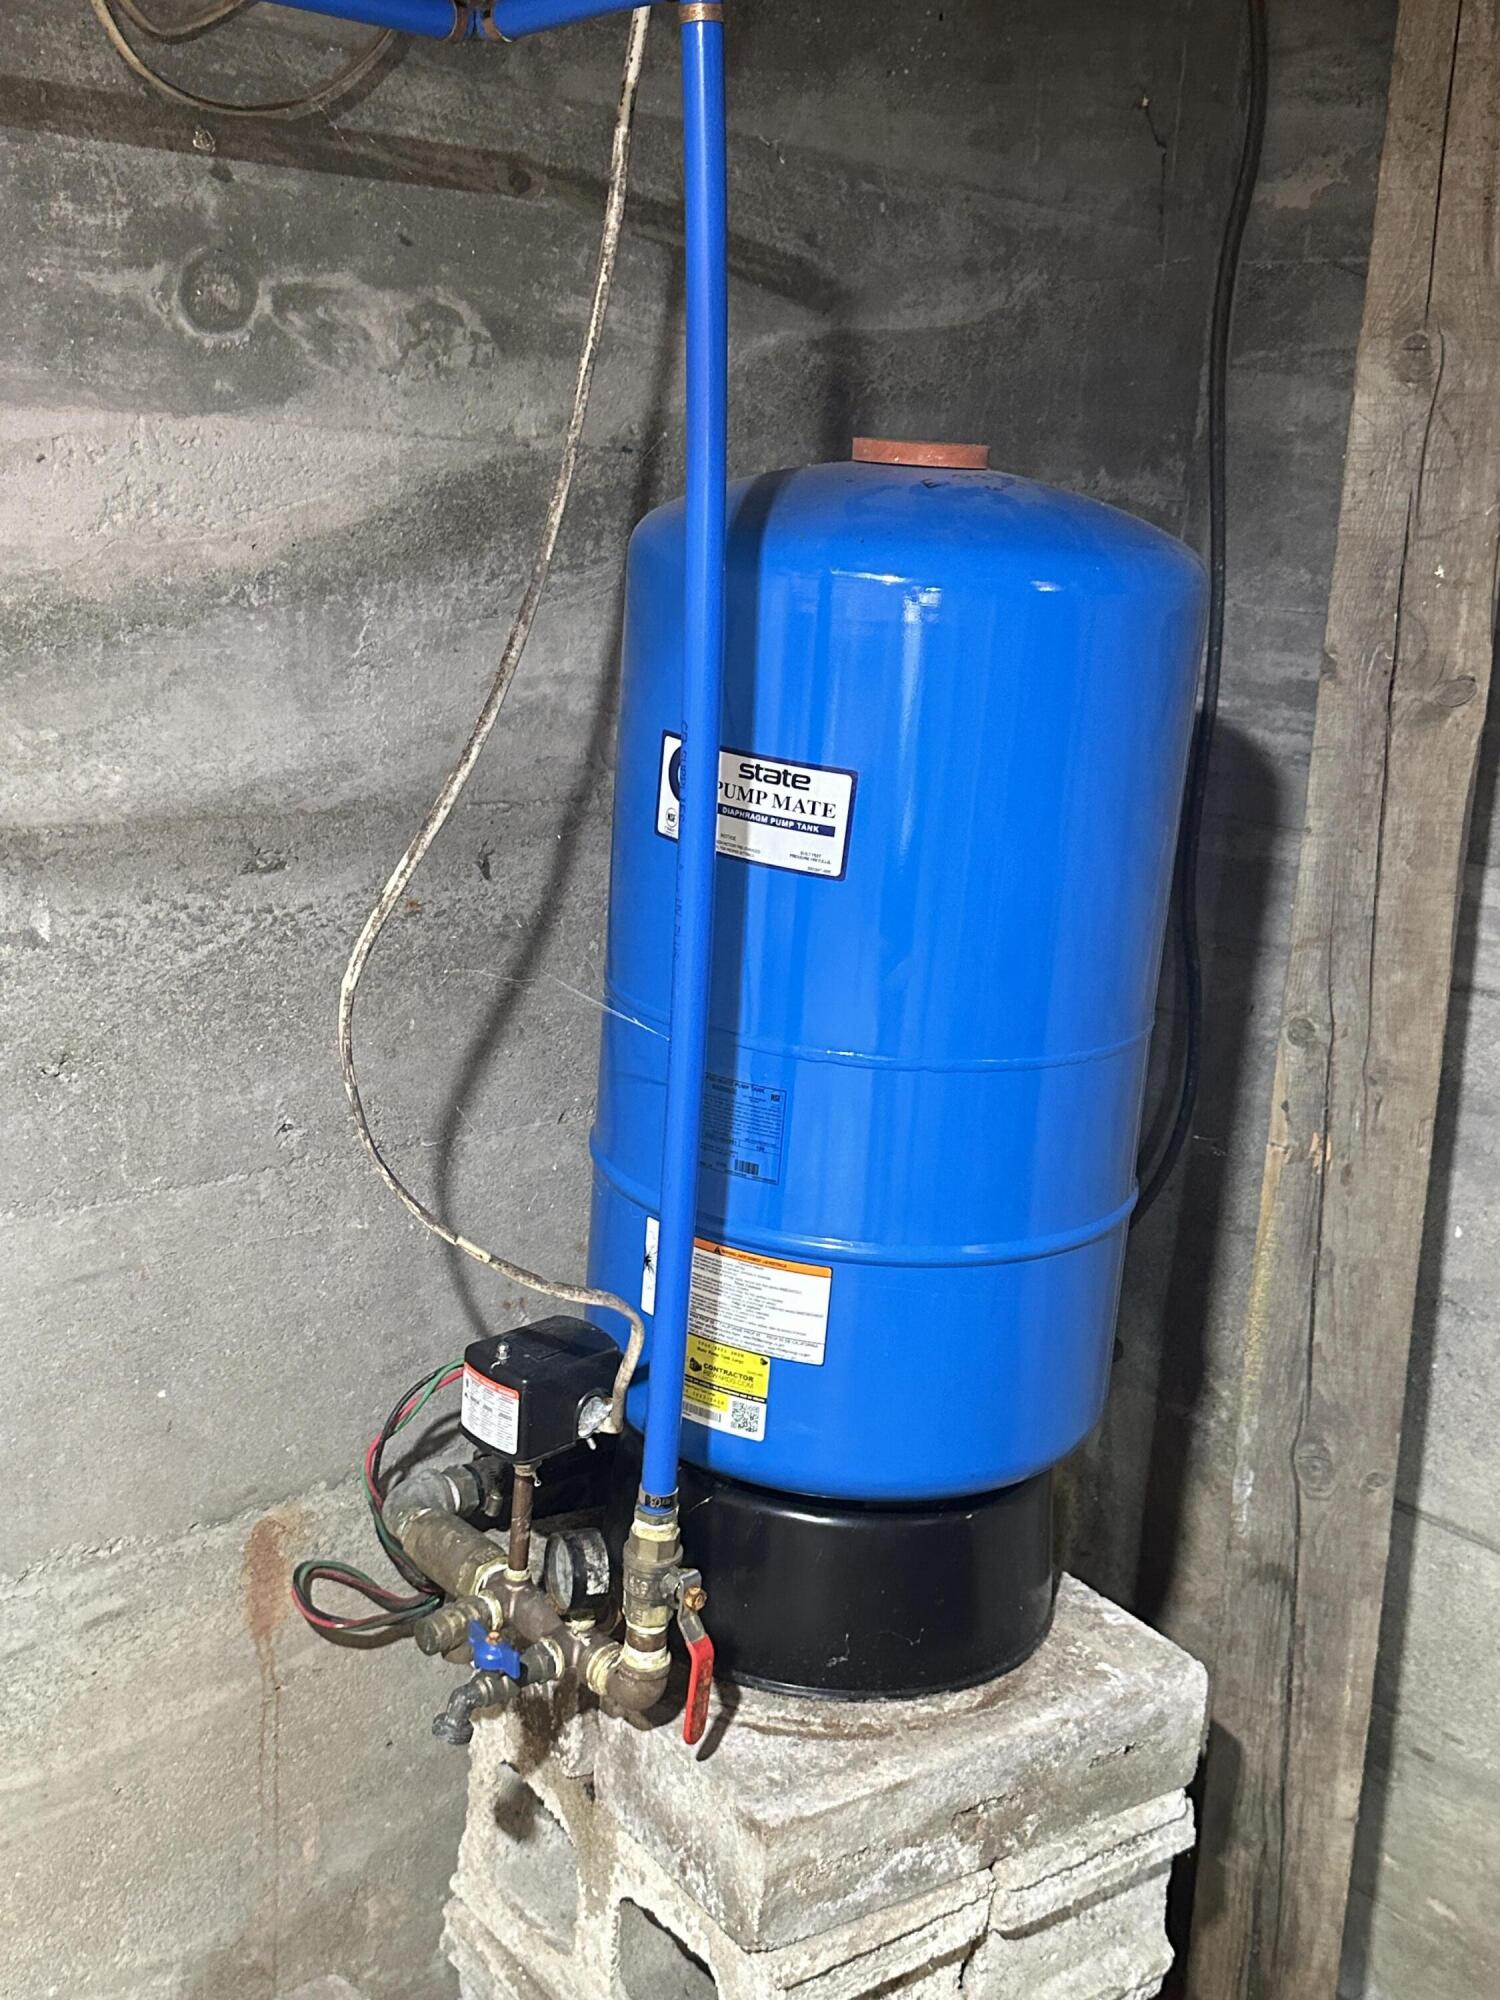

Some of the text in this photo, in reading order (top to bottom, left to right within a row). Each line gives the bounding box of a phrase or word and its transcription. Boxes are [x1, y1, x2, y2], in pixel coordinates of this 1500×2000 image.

[738, 762, 811, 791] state
[772, 793, 837, 819] MATE
[722, 807, 820, 834] DIAPHRAGM PUMP TANK
[703, 1362, 755, 1382] CONTRACTOR
